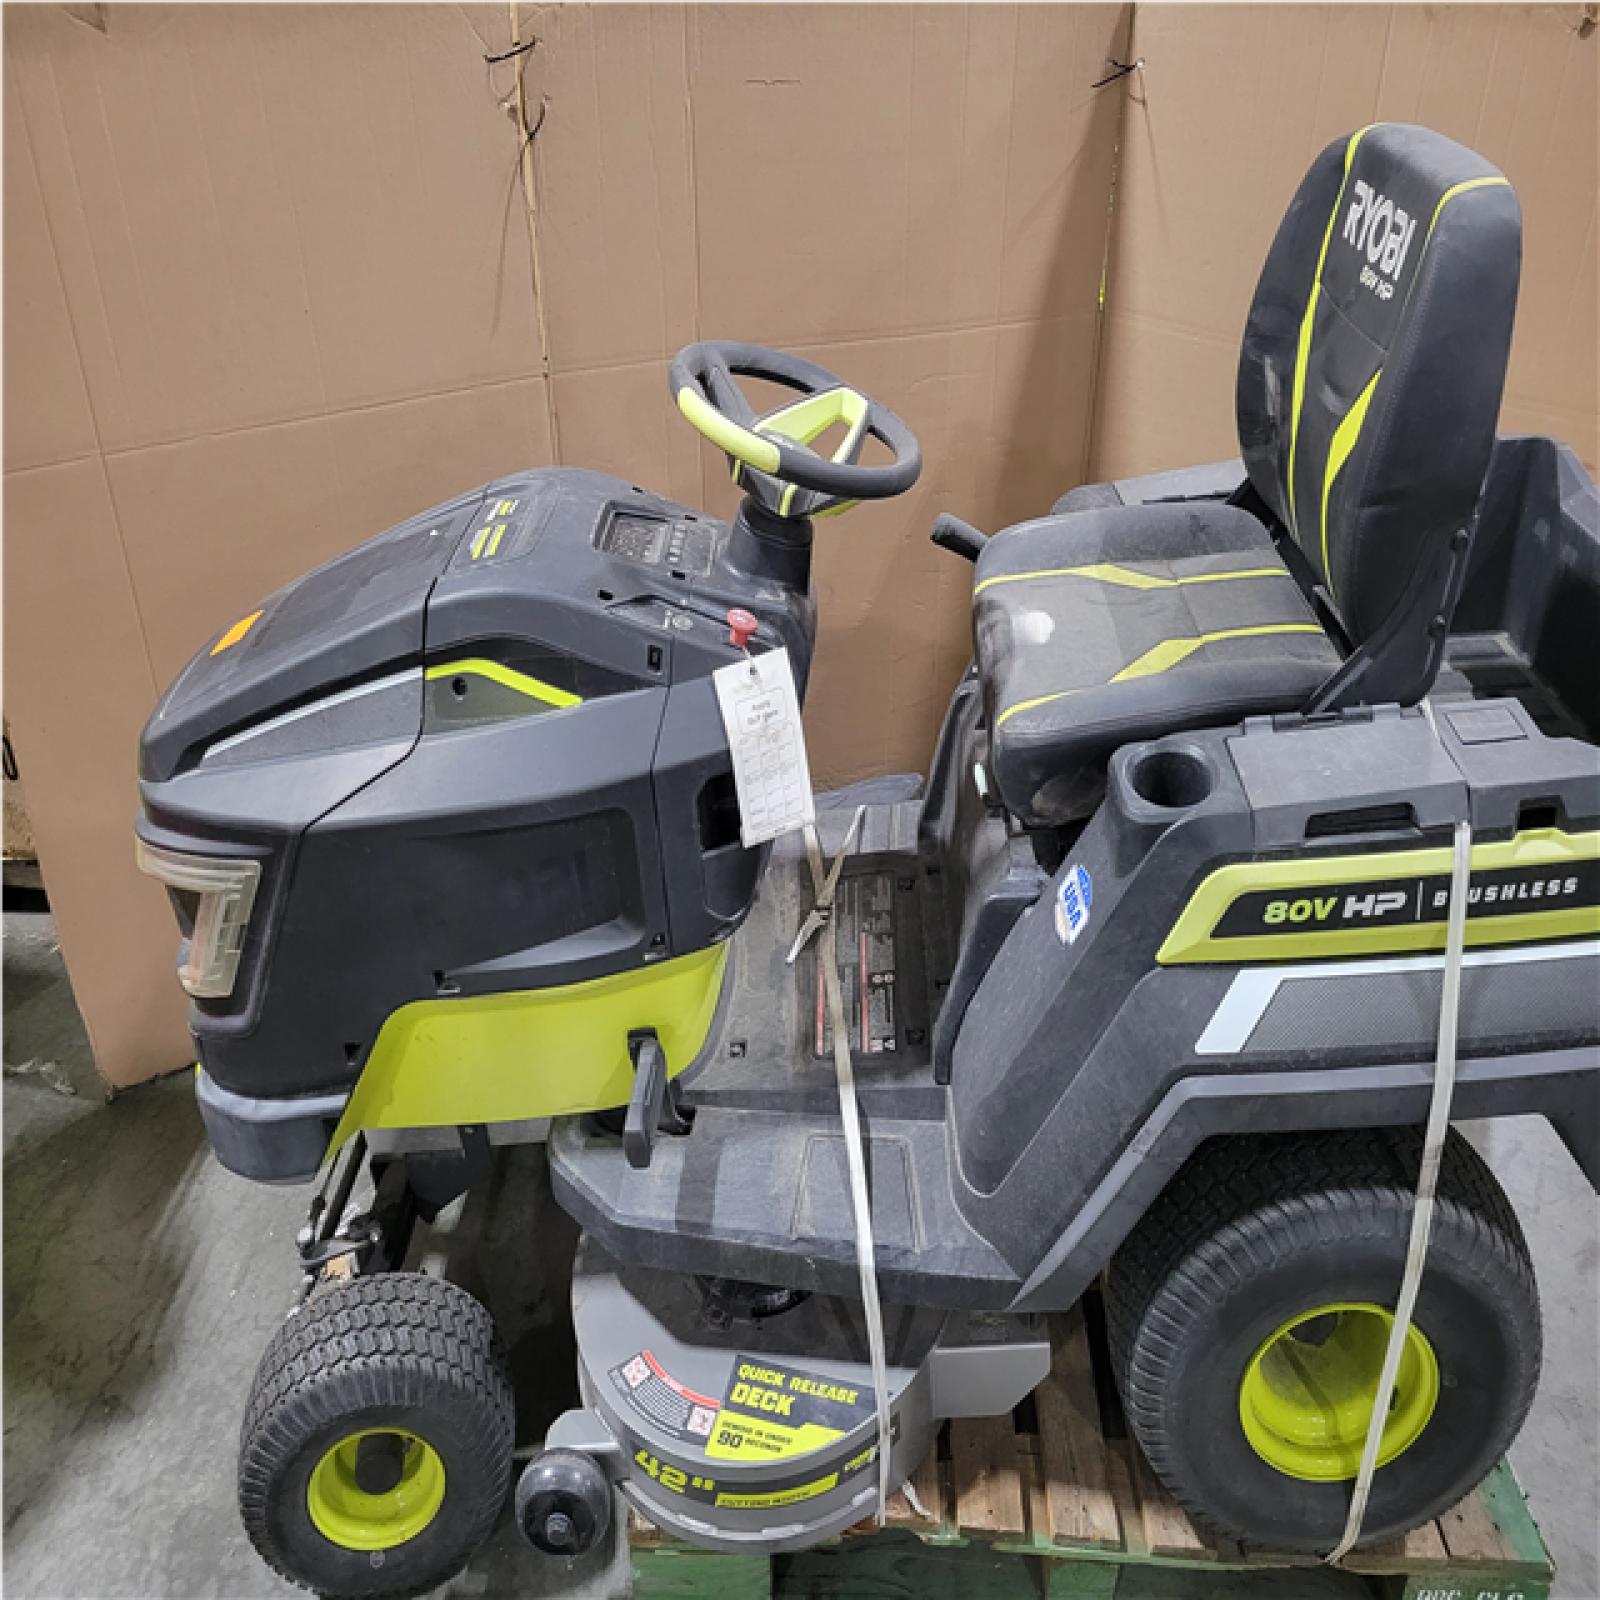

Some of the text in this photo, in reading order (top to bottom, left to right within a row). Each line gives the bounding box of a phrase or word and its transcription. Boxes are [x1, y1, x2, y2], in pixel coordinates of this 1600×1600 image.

[1342, 179, 1418, 281] RYOBI
[1263, 876, 1579, 924] 80V HP BUSHLESS
[730, 1382, 796, 1416] DECK
[738, 1363, 859, 1406] QUICK RELEASE
[717, 1430, 743, 1449] 90
